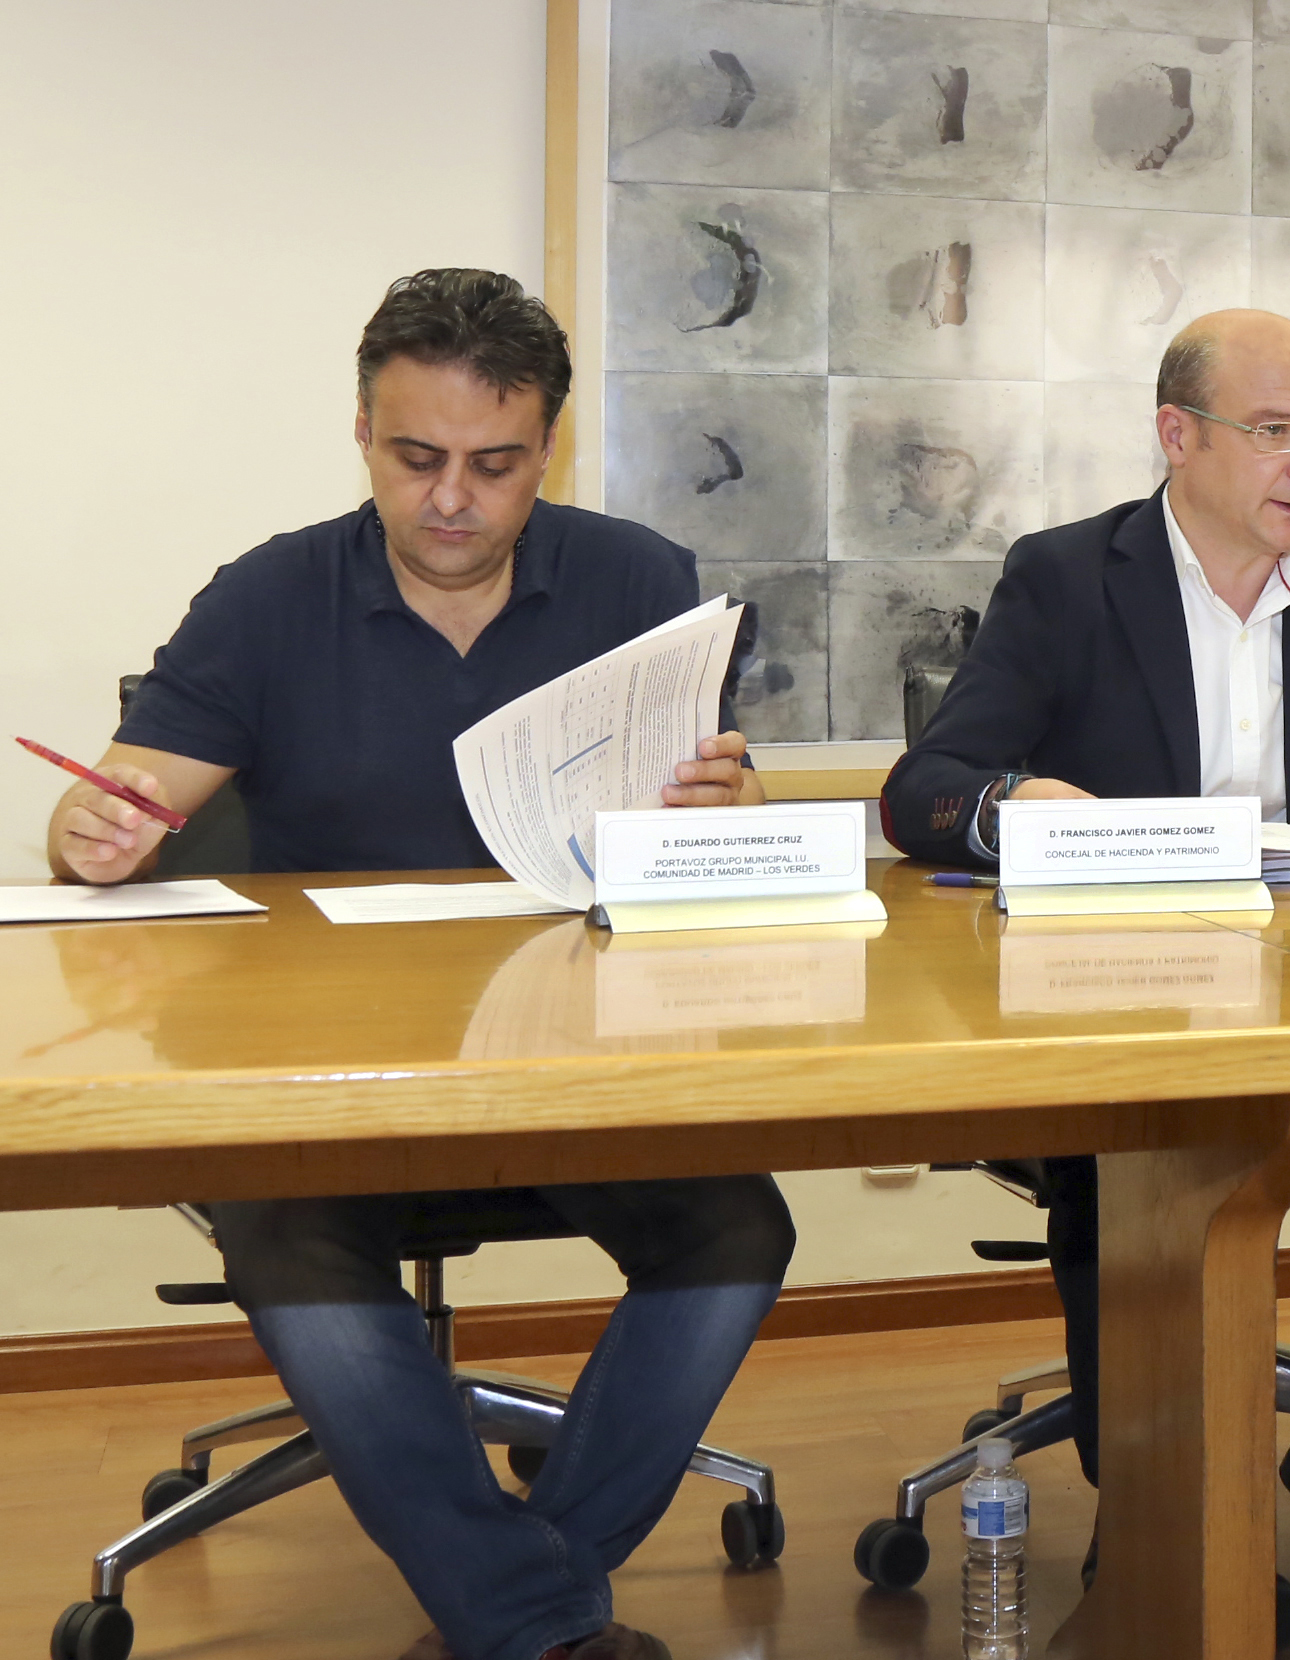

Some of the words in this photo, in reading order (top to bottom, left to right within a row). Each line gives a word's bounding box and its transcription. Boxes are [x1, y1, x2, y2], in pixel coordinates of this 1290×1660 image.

[1049, 830, 1058, 838] D.
[1061, 828, 1113, 838] FRANCISCO
[1115, 828, 1147, 837] JAVIER
[1149, 828, 1181, 836] GOMEZ
[1183, 826, 1215, 835] GOMEZ
[662, 840, 671, 848] D.
[674, 838, 721, 848] EDUARDO
[723, 836, 775, 846] GUTIERREZ
[777, 835, 802, 844] CRUZ
[1045, 850, 1092, 859] CONCEJAL
[1094, 849, 1106, 858] DE
[1109, 848, 1154, 857] HACIENDA
[1156, 848, 1162, 856] Y
[1164, 846, 1220, 855] PATRIMONIO
[655, 858, 706, 868] PORTAVOZ
[708, 857, 742, 866] GRUPO
[744, 855, 793, 864] MUNICIPAL
[643, 868, 700, 879] COMUNIDAD
[702, 868, 716, 877] DE
[718, 867, 754, 876] MADRID
[763, 866, 781, 875] LOS
[784, 864, 820, 873] VERDES
